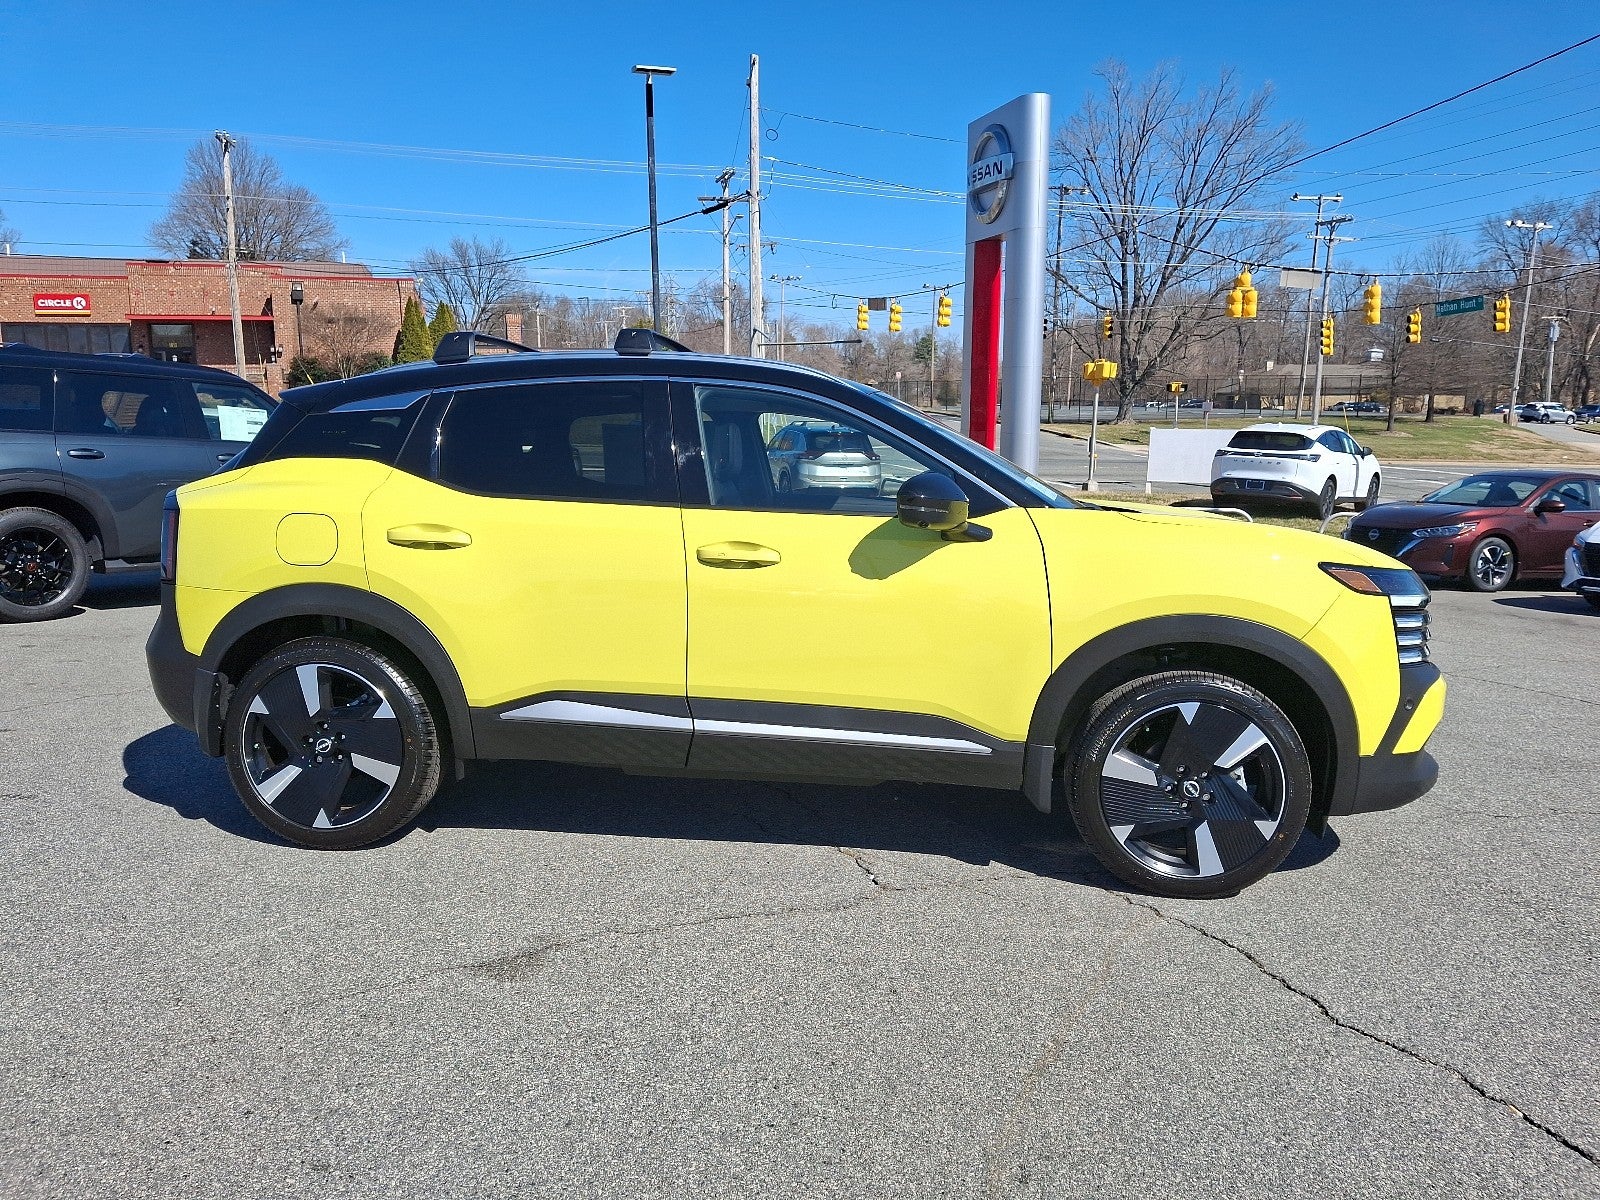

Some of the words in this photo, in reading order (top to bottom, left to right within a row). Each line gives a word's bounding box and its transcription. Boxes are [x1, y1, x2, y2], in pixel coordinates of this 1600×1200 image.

[37, 299, 72, 307] CIRCLE
[1436, 303, 1458, 313] Nathan
[1460, 299, 1476, 309] Hunt
